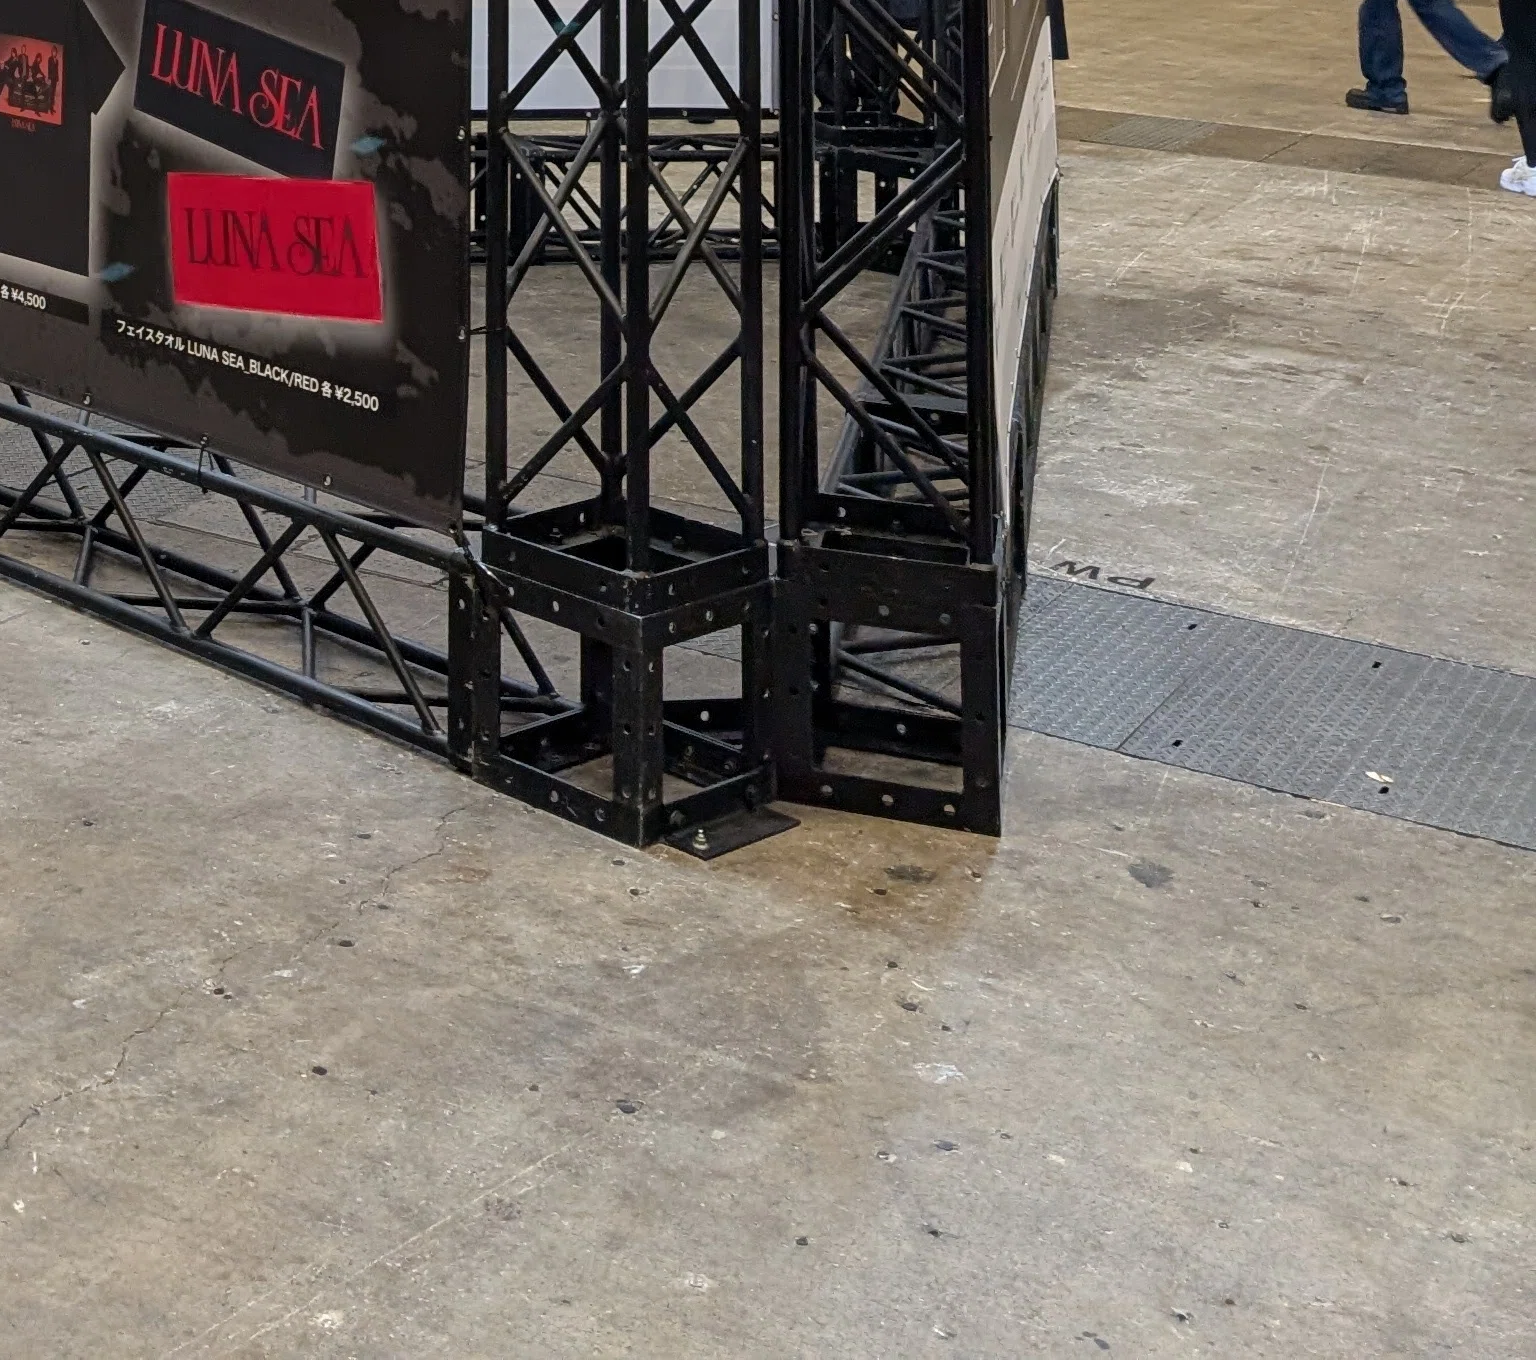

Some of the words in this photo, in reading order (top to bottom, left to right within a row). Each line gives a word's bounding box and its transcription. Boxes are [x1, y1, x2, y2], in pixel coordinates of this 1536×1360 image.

[151, 22, 242, 114] LUNA
[249, 66, 325, 150] SEA
[185, 206, 279, 273] LUNA
[286, 208, 366, 280] SEA
[116, 320, 185, 351] フェイスタオル
[187, 340, 220, 363] LUNA
[334, 385, 379, 411] ¥2,500
